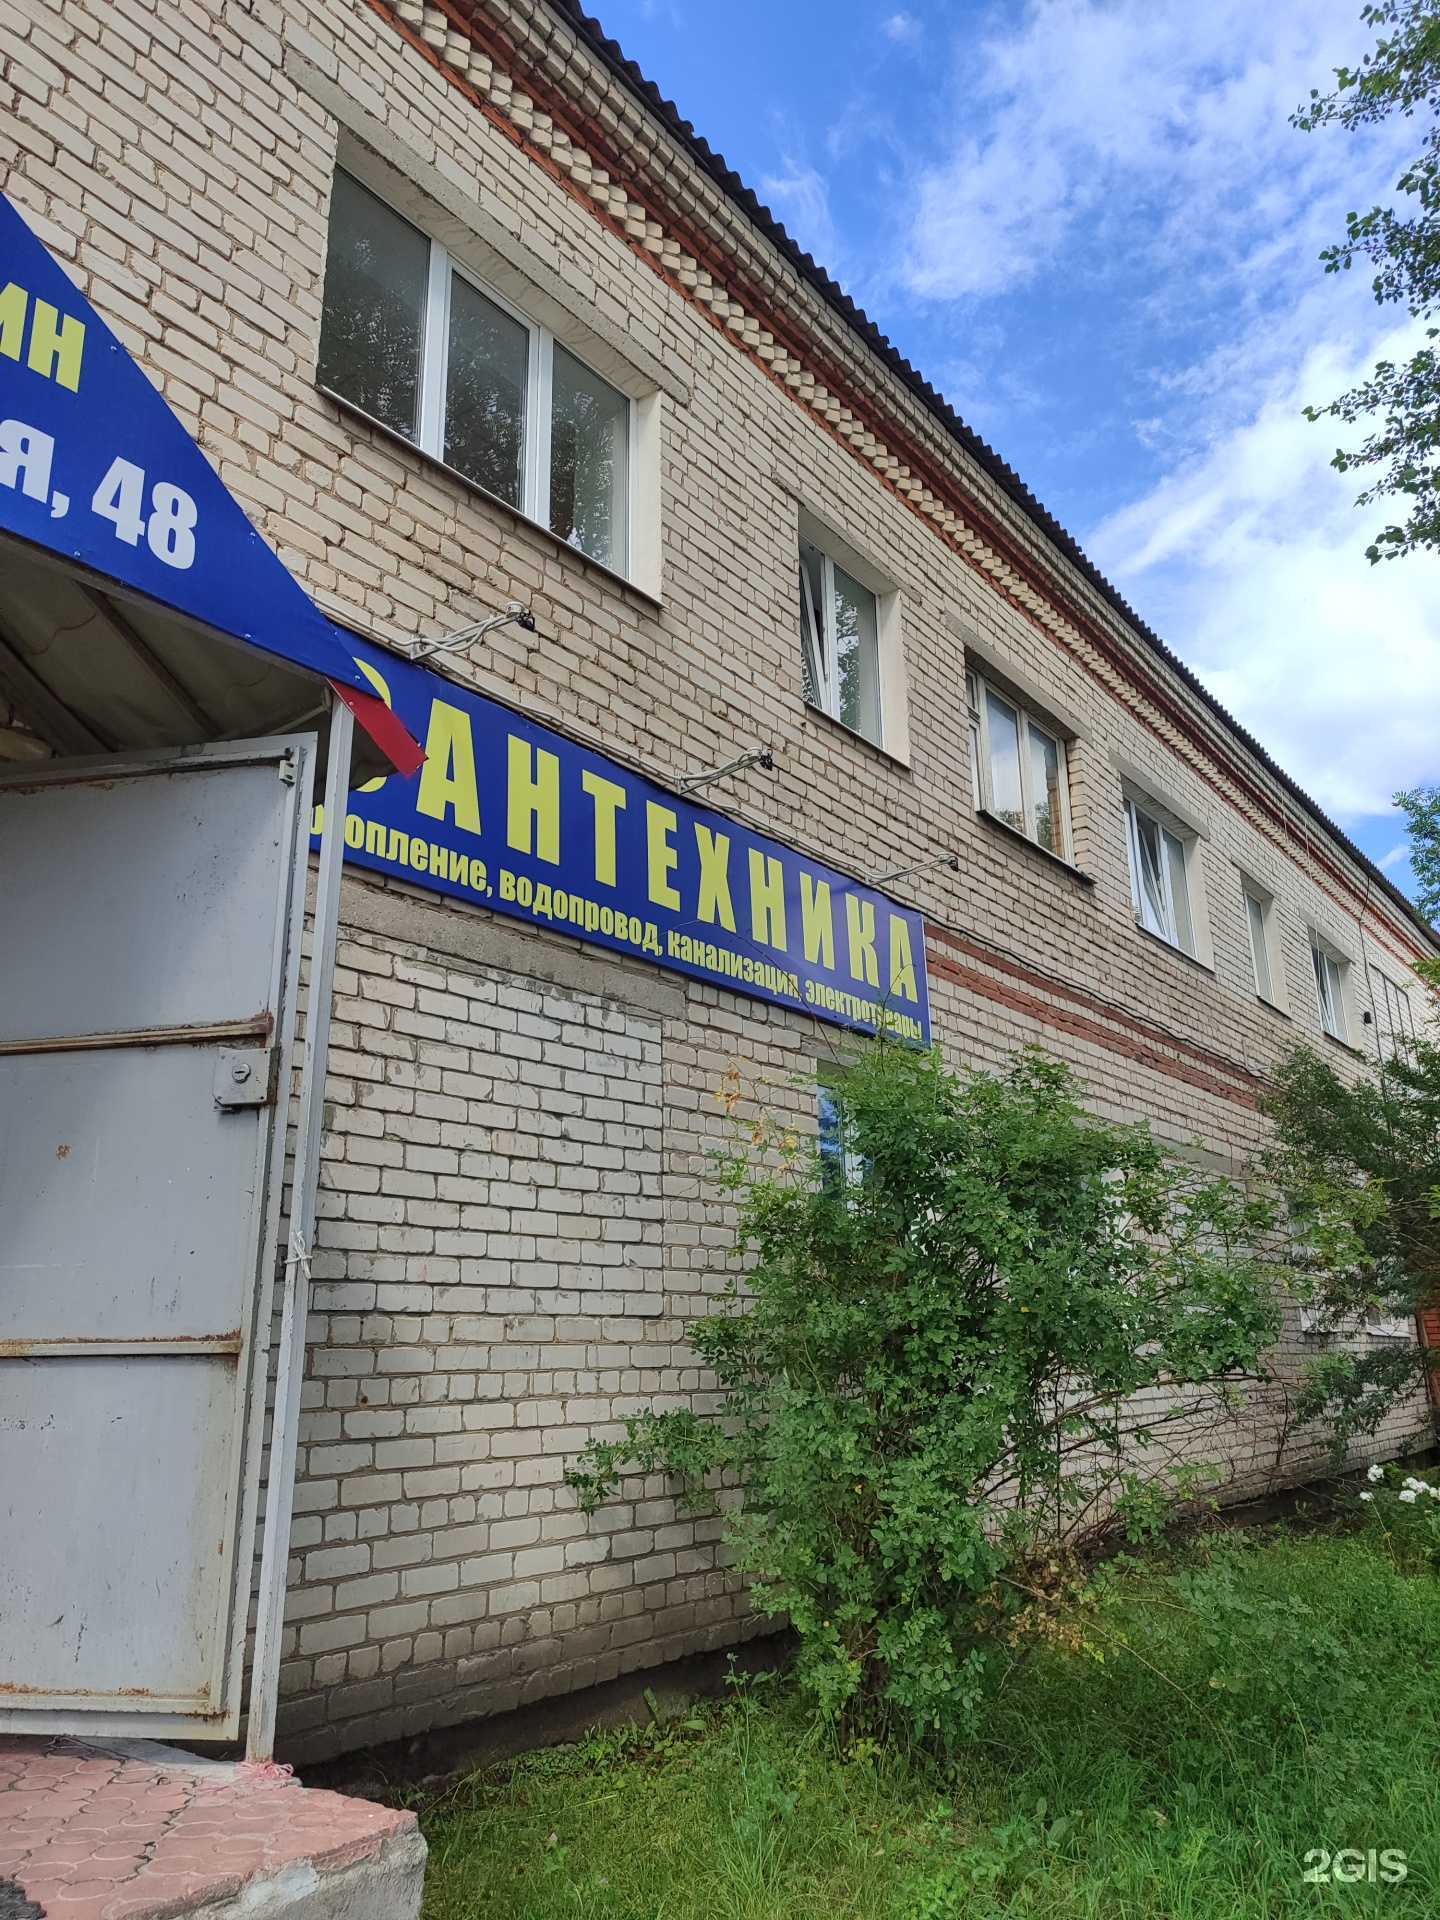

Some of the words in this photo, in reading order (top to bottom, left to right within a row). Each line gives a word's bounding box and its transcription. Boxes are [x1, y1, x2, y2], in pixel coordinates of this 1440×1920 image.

[91, 455, 198, 570] 48
[309, 803, 494, 897] опление,
[499, 868, 664, 956] водопровод,
[352, 656, 919, 1004] АНТЕХНИКА
